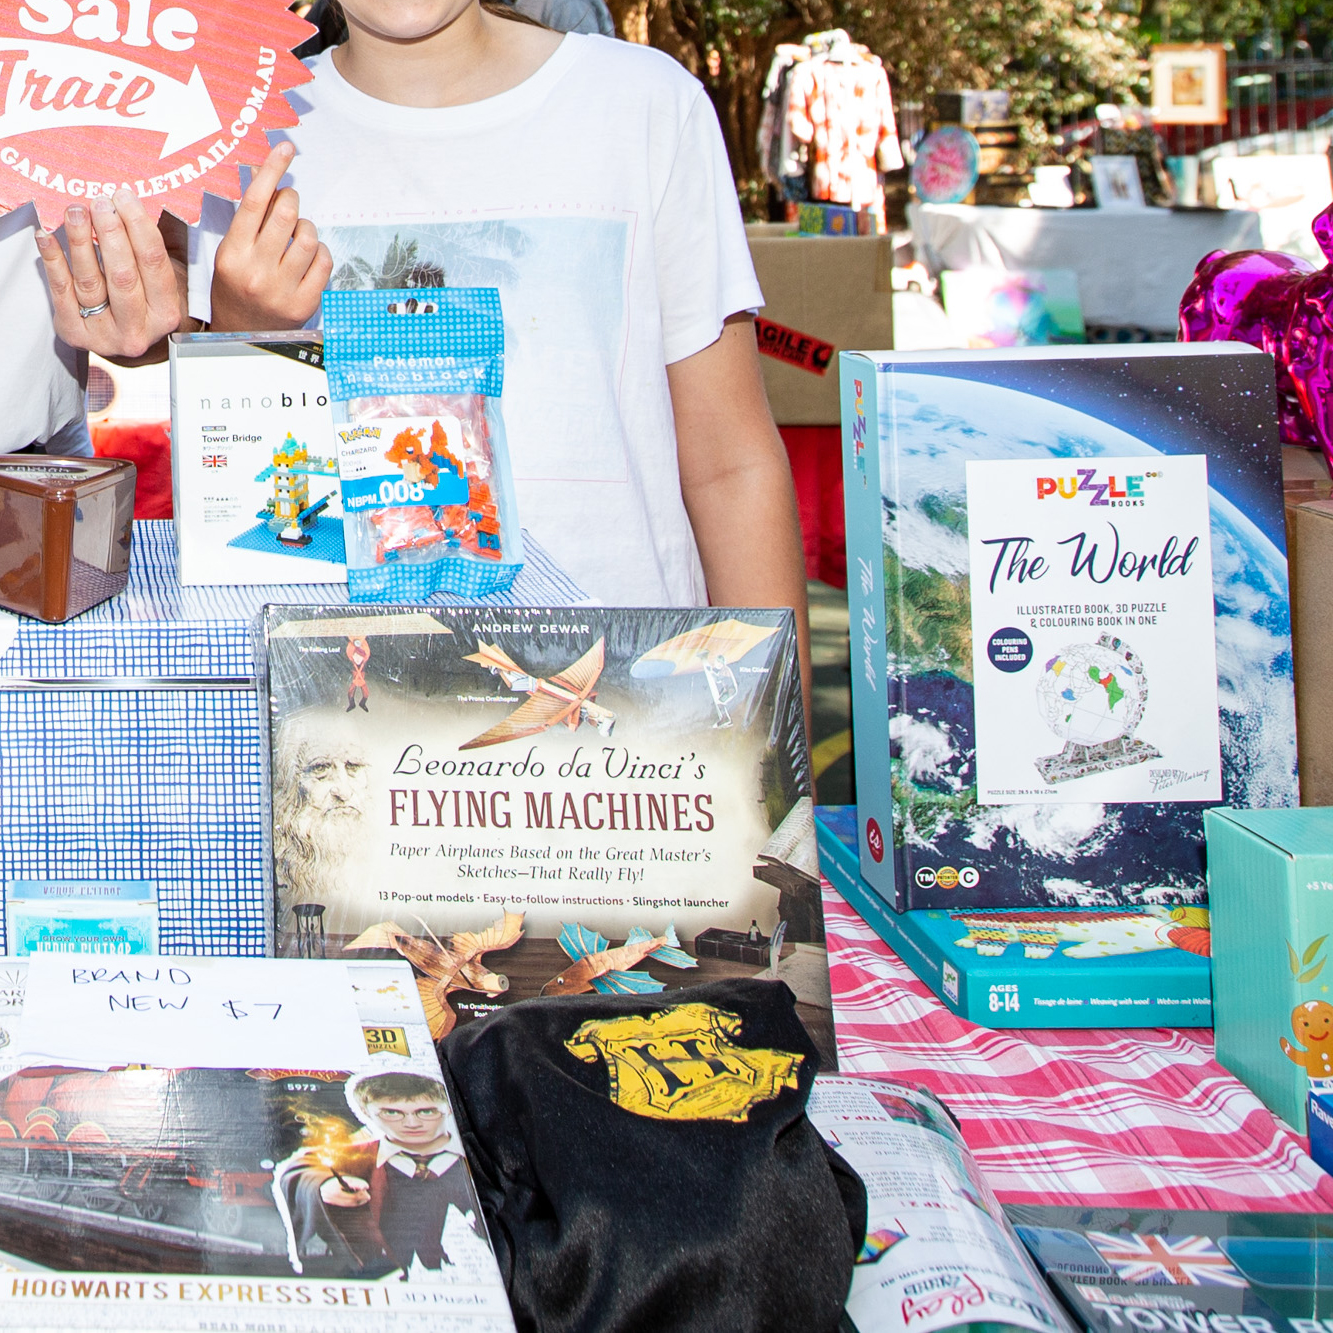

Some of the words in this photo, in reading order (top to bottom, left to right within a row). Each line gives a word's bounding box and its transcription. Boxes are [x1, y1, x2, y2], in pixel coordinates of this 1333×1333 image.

[755, 322, 812, 354] GILE
[373, 355, 455, 367] Pokémon
[347, 368, 487, 384] nanoblock
[200, 393, 327, 409] nanoblo
[202, 435, 229, 443] Tower
[232, 434, 262, 444] Bridge
[341, 446, 377, 456] CHARIZARD
[1037, 469, 1145, 506] PUZZLE
[1111, 500, 1145, 508] BOOKS
[981, 537, 1050, 594] The
[1057, 521, 1199, 584] World
[1017, 605, 1081, 615] ILLUSTRATED
[1084, 604, 1113, 615] BOOK,
[1116, 604, 1129, 613] 3D
[1131, 603, 1167, 613] PUZZLE
[1030, 619, 1037, 628] &
[1040, 618, 1094, 628] COLOURING
[1097, 617, 1122, 626] BOOK
[1125, 617, 1137, 626] IN
[1138, 616, 1157, 625] ONE
[472, 623, 534, 635] ANDREW
[540, 623, 590, 635] DEWAR
[992, 638, 1028, 646] COLOURING
[1001, 646, 1019, 654] PENS
[994, 653, 1026, 662] INCLUDED
[393, 744, 546, 780] Leonardo
[558, 747, 593, 780] da
[601, 747, 707, 782] Vinci's
[388, 789, 511, 830] FLYING
[525, 792, 715, 832] MACHINES
[390, 843, 430, 861] Paper
[434, 843, 504, 863] Airplanes
[509, 844, 549, 861] Based
[554, 850, 574, 861] on
[578, 846, 600, 861] the
[604, 846, 644, 862] Great
[649, 847, 712, 863] Master's
[567, 864, 611, 883] Really
[615, 865, 644, 884] Fly!
[919, 873, 934, 882] TM
[43, 886, 75, 896] VENUS
[1306, 882, 1319, 891] +5
[378, 891, 389, 902] 13
[391, 891, 431, 905] Pop-out
[435, 892, 474, 904] models
[483, 893, 559, 907] Easy-to-follow
[562, 895, 624, 906] instructions
[632, 895, 681, 910] Slingshot
[684, 897, 729, 909] launcher
[72, 967, 192, 986] BRAND
[989, 984, 1018, 992] AGES
[108, 995, 189, 1012] NEW
[222, 1000, 282, 1021] $7
[989, 993, 1020, 1012] 8-14
[1090, 998, 1118, 1007] Weaving
[366, 1029, 397, 1043] 3D
[287, 1083, 317, 1092] 5972
[1310, 1097, 1333, 1128] Rave
[12, 1278, 169, 1300] HOGWARTS
[179, 1281, 312, 1305] EXPRESS
[322, 1285, 374, 1307] SET
[434, 1292, 488, 1306] Puzzle
